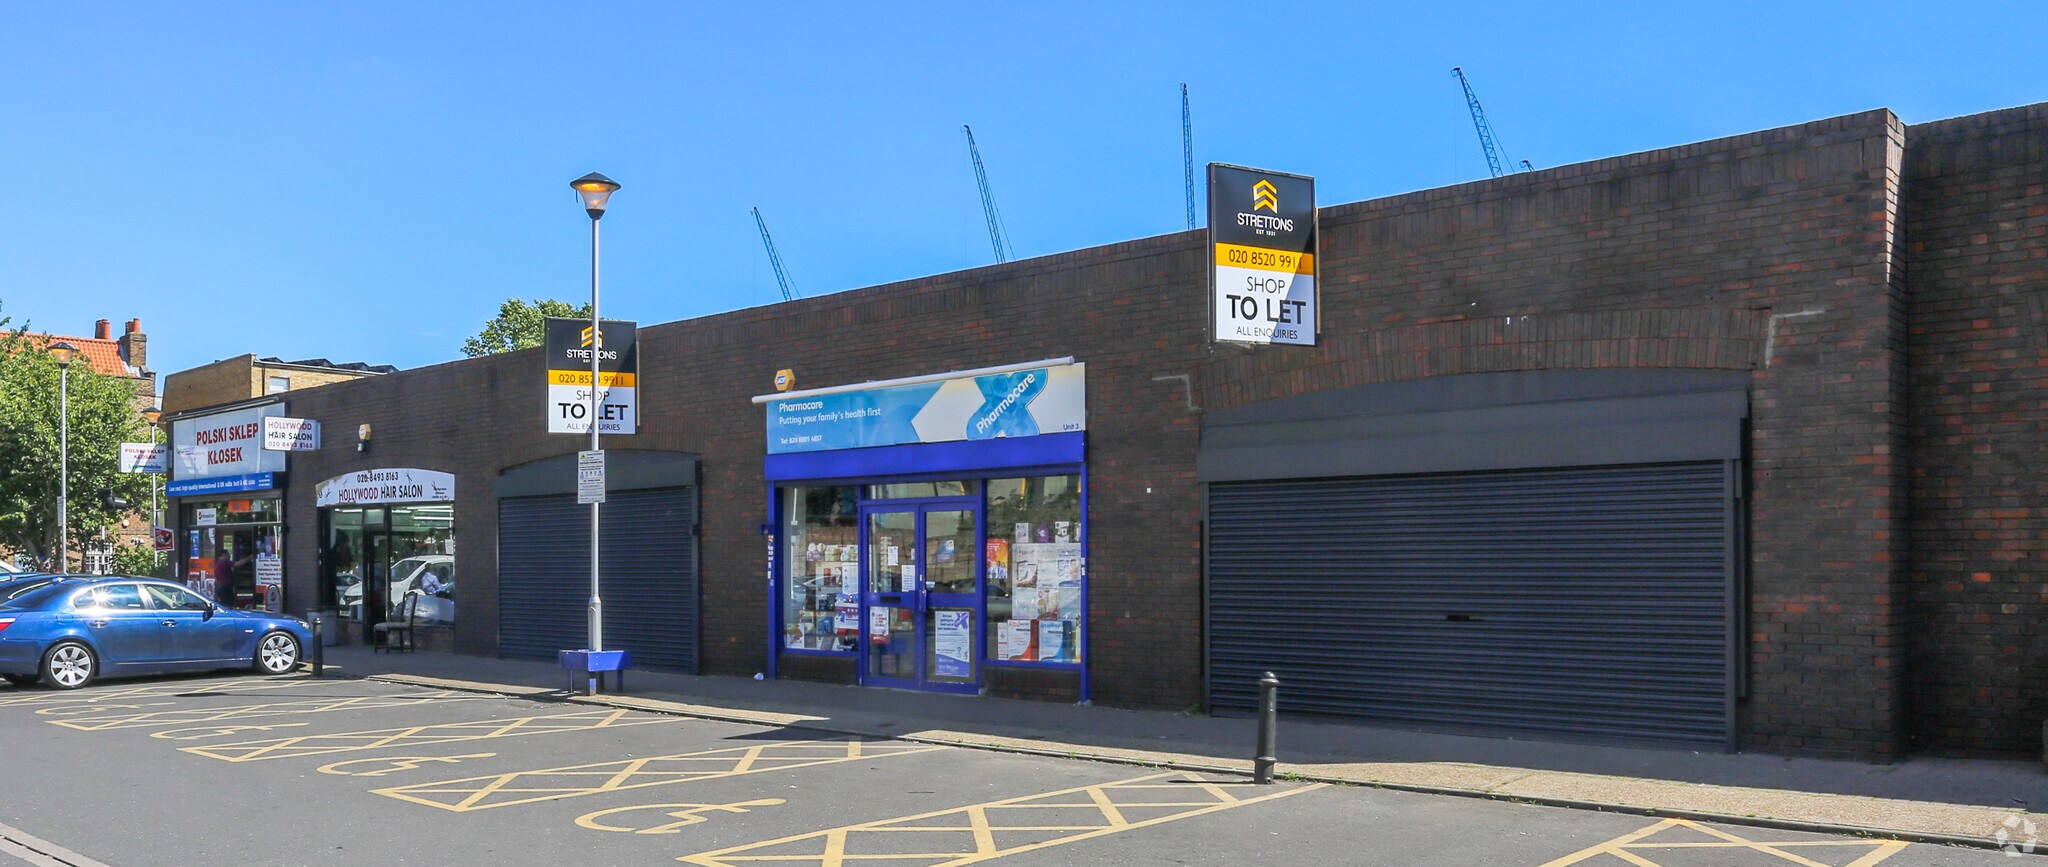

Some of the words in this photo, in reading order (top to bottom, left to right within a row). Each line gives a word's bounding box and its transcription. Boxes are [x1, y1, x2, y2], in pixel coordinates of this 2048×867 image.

[1237, 212, 1294, 232] STRETTONS
[1228, 249, 1248, 264] 020
[1251, 251, 1276, 267] 8520
[1279, 254, 1302, 270] 9911
[1246, 276, 1286, 294] SHOP
[1226, 294, 1258, 321] TO
[1266, 298, 1307, 325] LET
[1236, 326, 1252, 336] ALL
[1254, 327, 1298, 340] ENQUIRIES
[566, 349, 617, 360] STRETONS
[558, 373, 576, 384] 020
[603, 376, 624, 385] 9911
[558, 402, 586, 419] TO
[779, 401, 823, 413] Pharmocare
[976, 373, 1036, 434] Pharmocare
[779, 416, 802, 426] Putting
[803, 415, 817, 425] your
[818, 411, 844, 423] family's
[844, 409, 866, 419] health
[867, 407, 881, 416] first
[196, 428, 227, 446] POLSKI
[229, 422, 259, 442] SKLEP
[268, 421, 312, 431] HOLLYWOOD
[582, 423, 621, 431] ENUIRIES
[288, 432, 313, 441] SALON
[207, 446, 243, 465] KŁOSEK
[369, 472, 384, 482] 8493
[385, 471, 399, 481] 8163
[338, 487, 379, 501] HOLLYWOOD
[380, 485, 397, 499] HAIR
[398, 484, 423, 498] SALON
